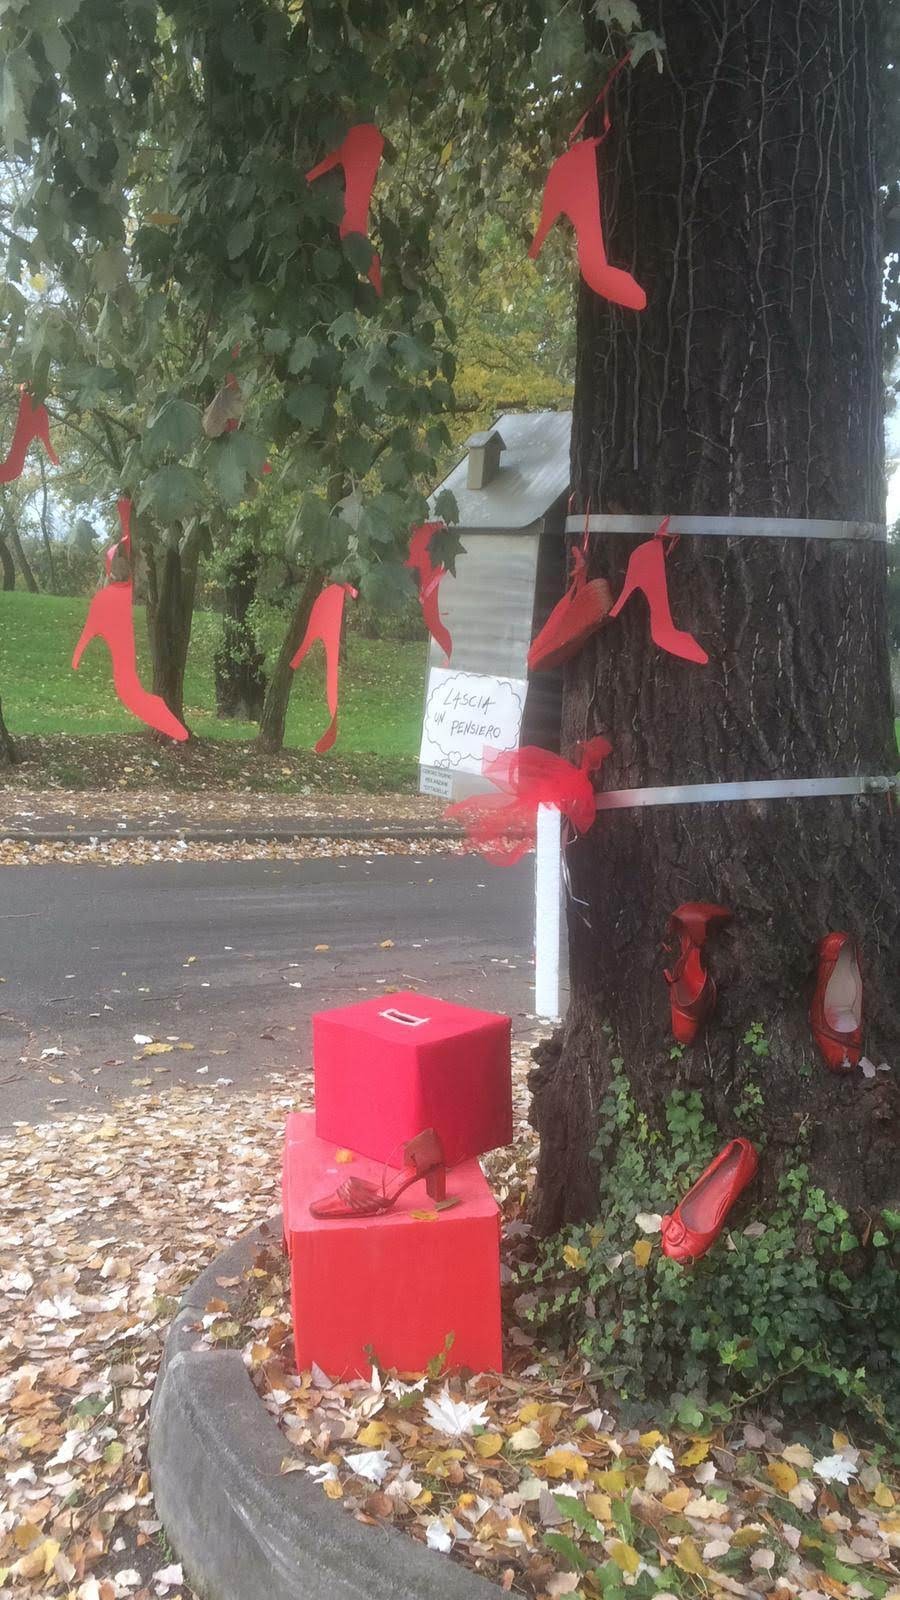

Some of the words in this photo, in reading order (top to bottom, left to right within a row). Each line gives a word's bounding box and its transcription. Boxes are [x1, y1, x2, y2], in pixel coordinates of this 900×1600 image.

[443, 688, 496, 715] LASCIA
[434, 711, 446, 725] UN
[450, 720, 501, 739] PENSIERO
